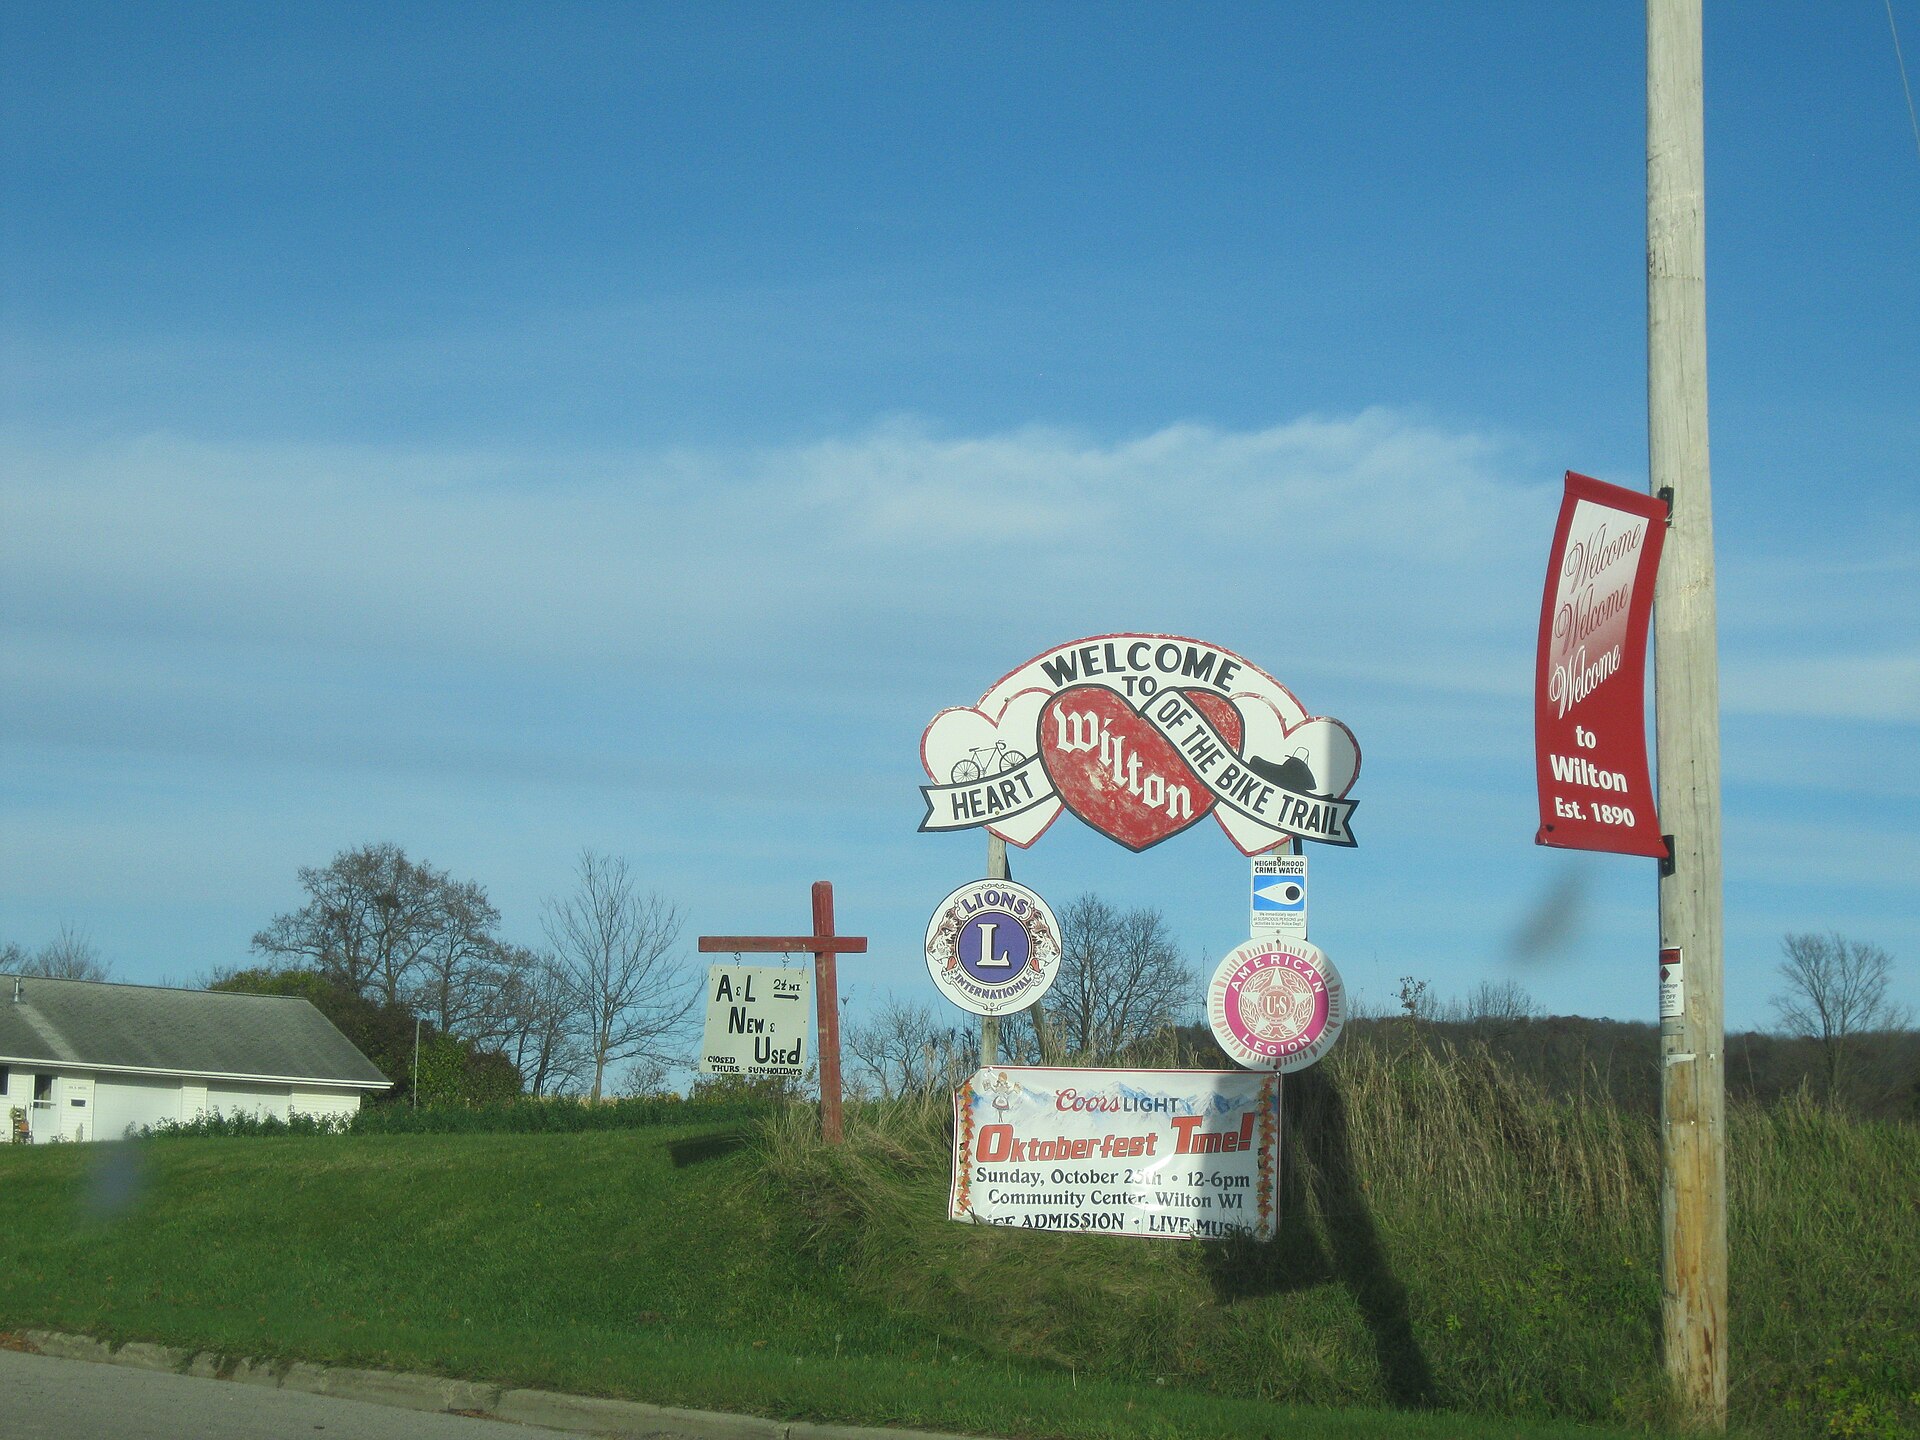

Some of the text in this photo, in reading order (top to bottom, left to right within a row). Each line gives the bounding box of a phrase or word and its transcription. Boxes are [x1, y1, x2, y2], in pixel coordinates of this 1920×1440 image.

[1564, 522, 1641, 594] Welcome
[1554, 582, 1629, 656] Welcome
[1040, 641, 1244, 694] WELCOME
[1549, 644, 1621, 720] Welcome
[1121, 675, 1158, 698] TO
[1575, 725, 1597, 749] to
[1054, 703, 1195, 820] Wilton
[1157, 699, 1342, 836] OF THE BIKE TRAIL
[1550, 754, 1628, 793] Wilton
[951, 770, 1034, 820] HEART
[1554, 796, 1636, 827] Est. 1890
[960, 889, 1029, 915] LIONS
[976, 923, 1010, 967] L
[716, 974, 733, 1002] A
[744, 974, 756, 1002] L
[955, 973, 1032, 999] INTERNATIONAL
[1230, 955, 1325, 994] AMERICAN
[1242, 1033, 1311, 1054] LEGION
[711, 1065, 740, 1073] THURS
[1055, 1088, 1180, 1113] Coors LIGHT
[976, 1112, 1256, 1163] Oktoberfest Time!
[976, 1167, 1045, 1187] Sunday,
[1050, 1169, 1119, 1184] October
[1187, 1171, 1250, 1190] 12-6pm
[988, 1189, 1086, 1209] Community
[1155, 1191, 1212, 1208] Wilton
[1217, 1193, 1243, 1209] WI
[1022, 1212, 1125, 1230] ADMISSION
[1148, 1214, 1192, 1233] LIVE
